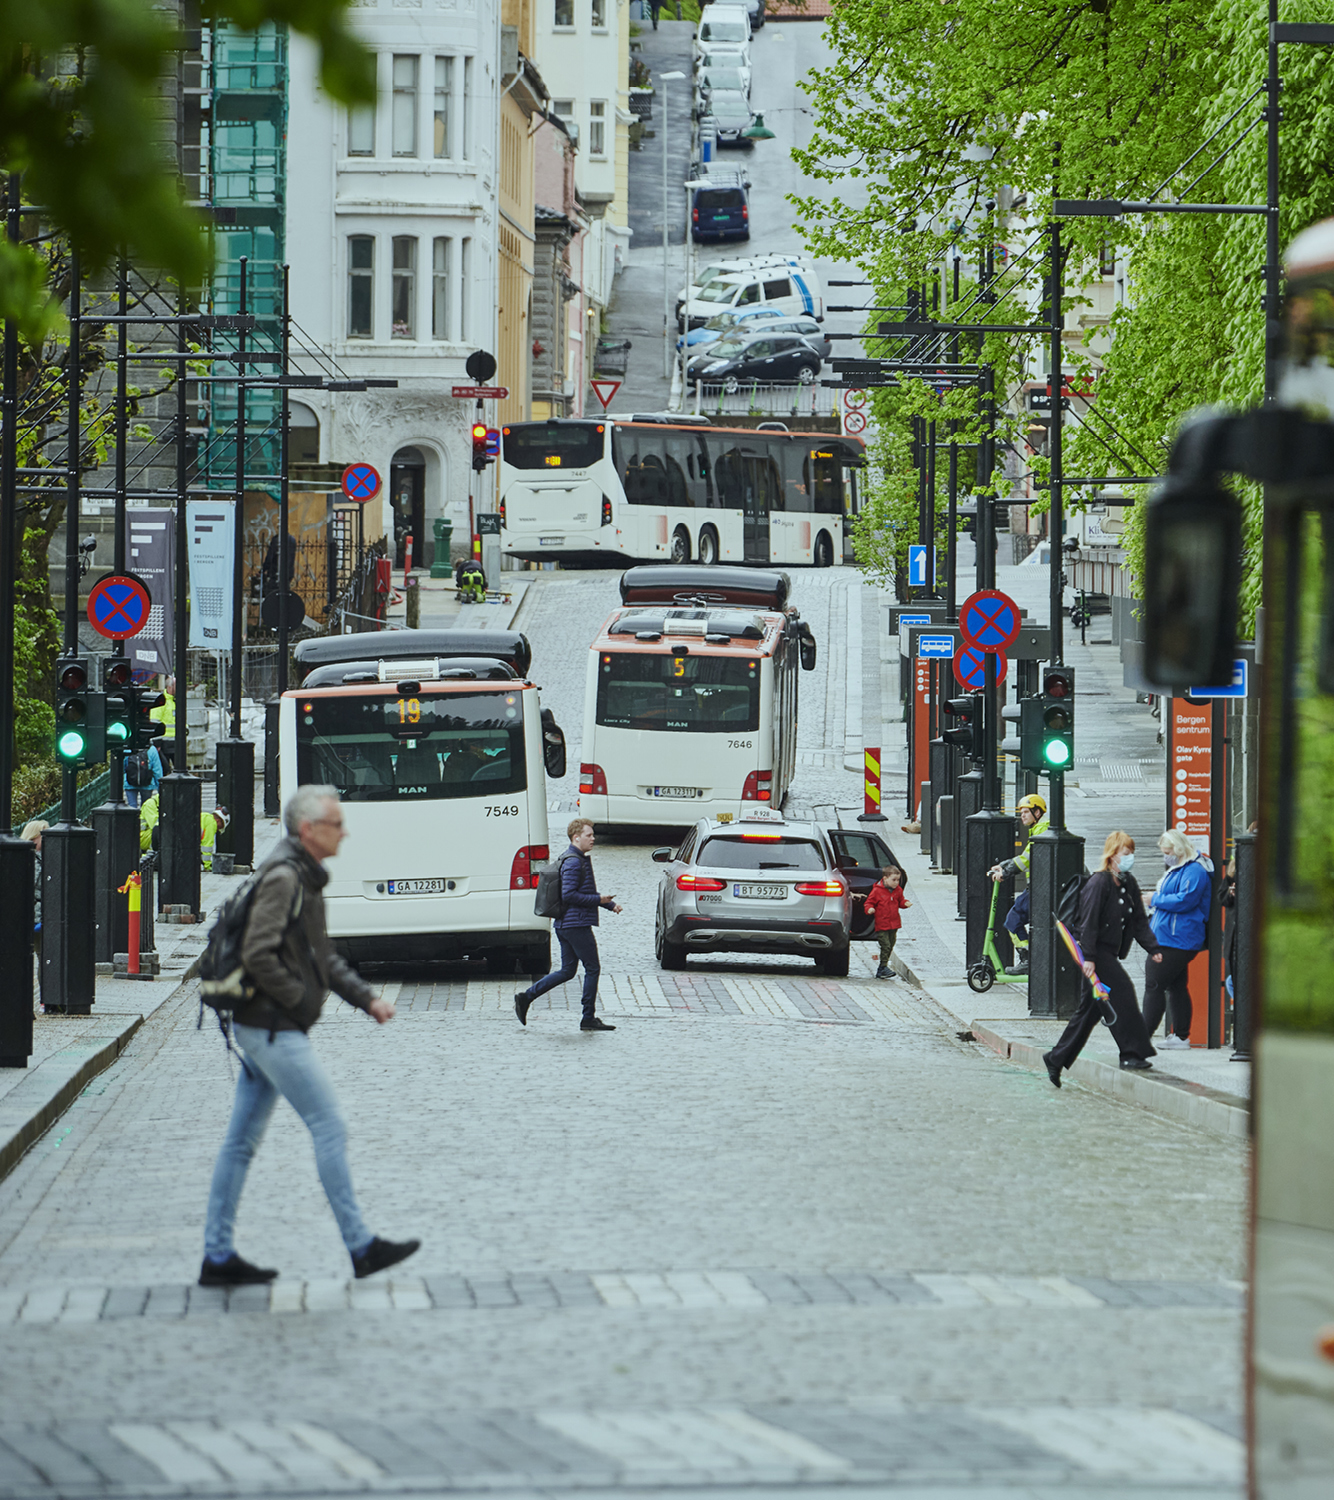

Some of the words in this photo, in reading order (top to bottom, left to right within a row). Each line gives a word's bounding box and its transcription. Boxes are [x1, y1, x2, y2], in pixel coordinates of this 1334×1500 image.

[138, 652, 156, 660] DNB
[674, 658, 684, 677] 5
[397, 698, 421, 724] 19
[1176, 715, 1206, 725] Bergen
[728, 740, 752, 748] 7646
[484, 806, 519, 817] 7549
[398, 880, 410, 891] GA
[414, 880, 442, 890] 12281
[757, 887, 784, 895] 95775
